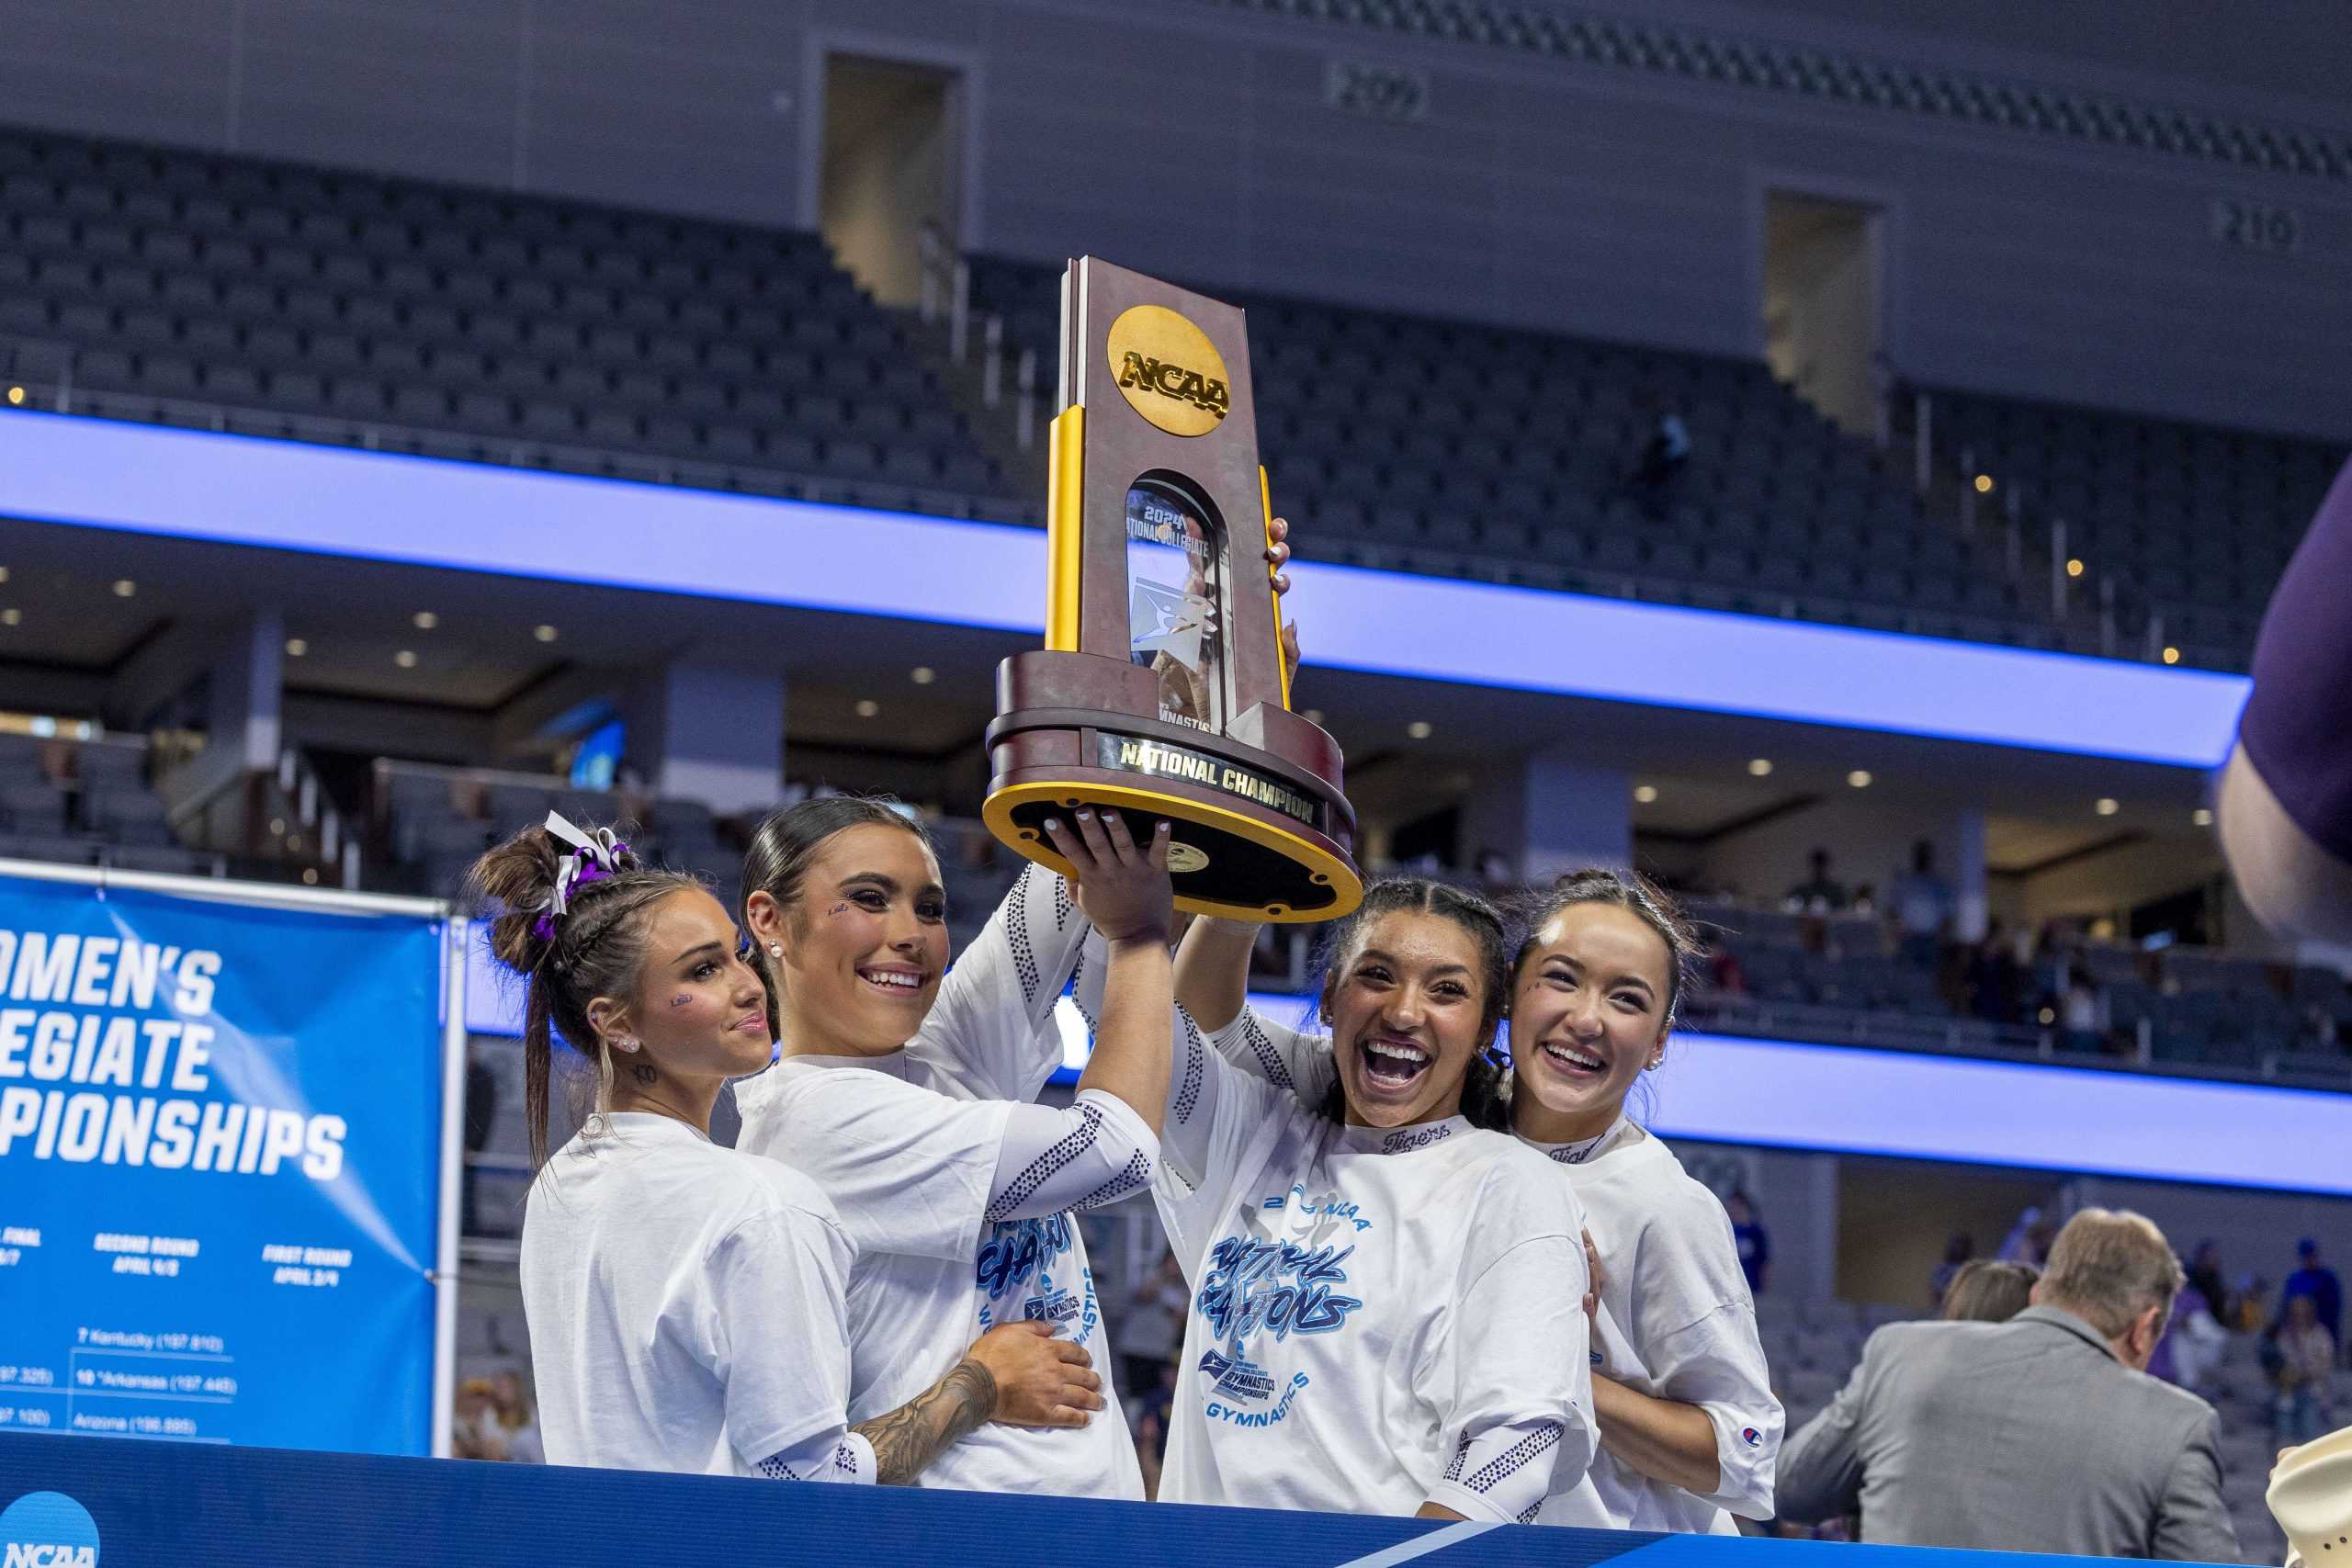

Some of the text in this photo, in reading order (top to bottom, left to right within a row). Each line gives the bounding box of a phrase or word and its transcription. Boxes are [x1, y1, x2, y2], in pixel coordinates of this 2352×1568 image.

[1119, 351, 1230, 420] NCAA
[1145, 505, 1183, 530] 2024
[1120, 741, 1314, 825] NATIONAL CHAMPION
[1381, 1124, 1452, 1155] Tigers
[89, 1329, 154, 1351] Kentucky
[1224, 1371, 1275, 1392] GYMNASTICS
[1205, 1371, 1310, 1427] GYMNASTICS
[74, 1412, 129, 1431] Arizona
[3, 1542, 96, 1568] NCAA
